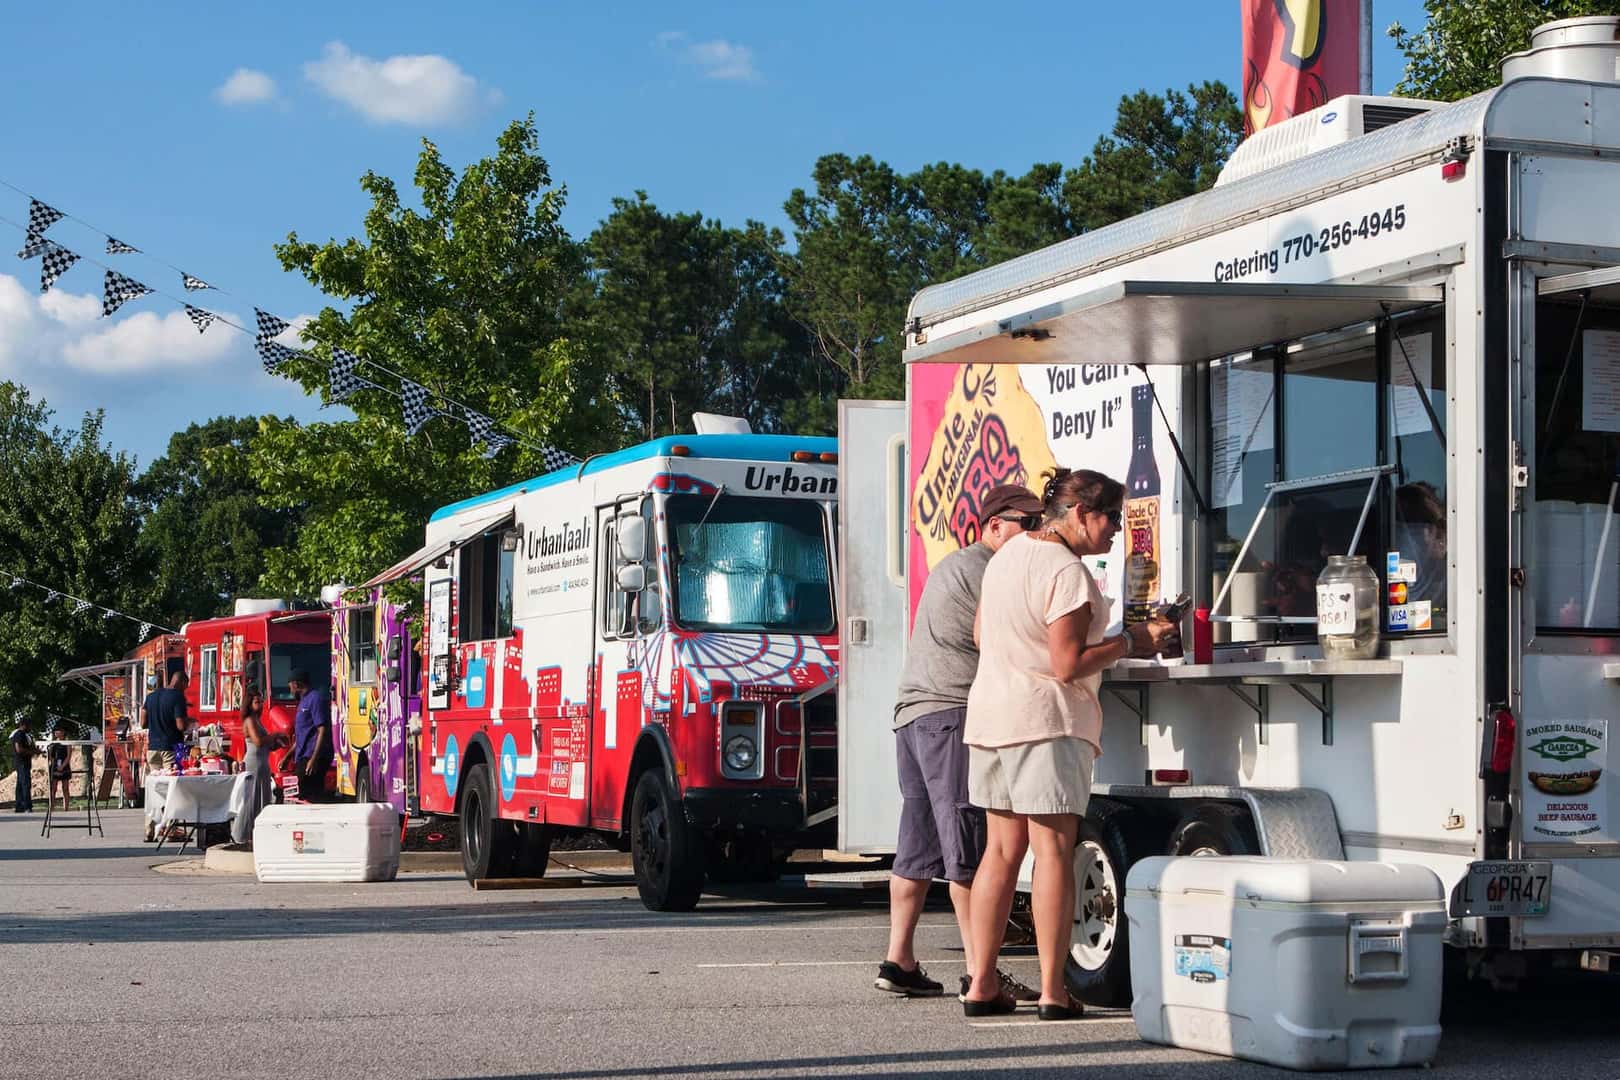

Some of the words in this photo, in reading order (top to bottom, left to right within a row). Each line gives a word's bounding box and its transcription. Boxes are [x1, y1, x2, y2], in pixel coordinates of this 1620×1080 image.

[1214, 249, 1279, 282] Catering
[1283, 204, 1406, 264] 770-256-4945
[1047, 366, 1075, 394] You
[1082, 364, 1129, 386] Can
[1053, 410, 1096, 440] Deny
[918, 411, 966, 524] Uncle
[947, 408, 984, 502] ORIGINAL
[744, 466, 838, 495] Urban
[950, 413, 1021, 548] BBQ
[1127, 502, 1146, 519] Uncle
[528, 515, 591, 560] UrbanTaali
[1131, 526, 1153, 560] BBQ
[1391, 609, 1408, 622] VISA
[1526, 724, 1562, 737] SMOKED
[1564, 723, 1603, 739] SAUSAGE
[1547, 743, 1579, 752] GARCIA
[1538, 814, 1560, 822] BEEF
[1561, 813, 1597, 821] SAUSAGE
[1546, 803, 1588, 811] DELICIOUS
[1473, 863, 1527, 874] GEORGIA
[1487, 876, 1547, 903] 6PR47
